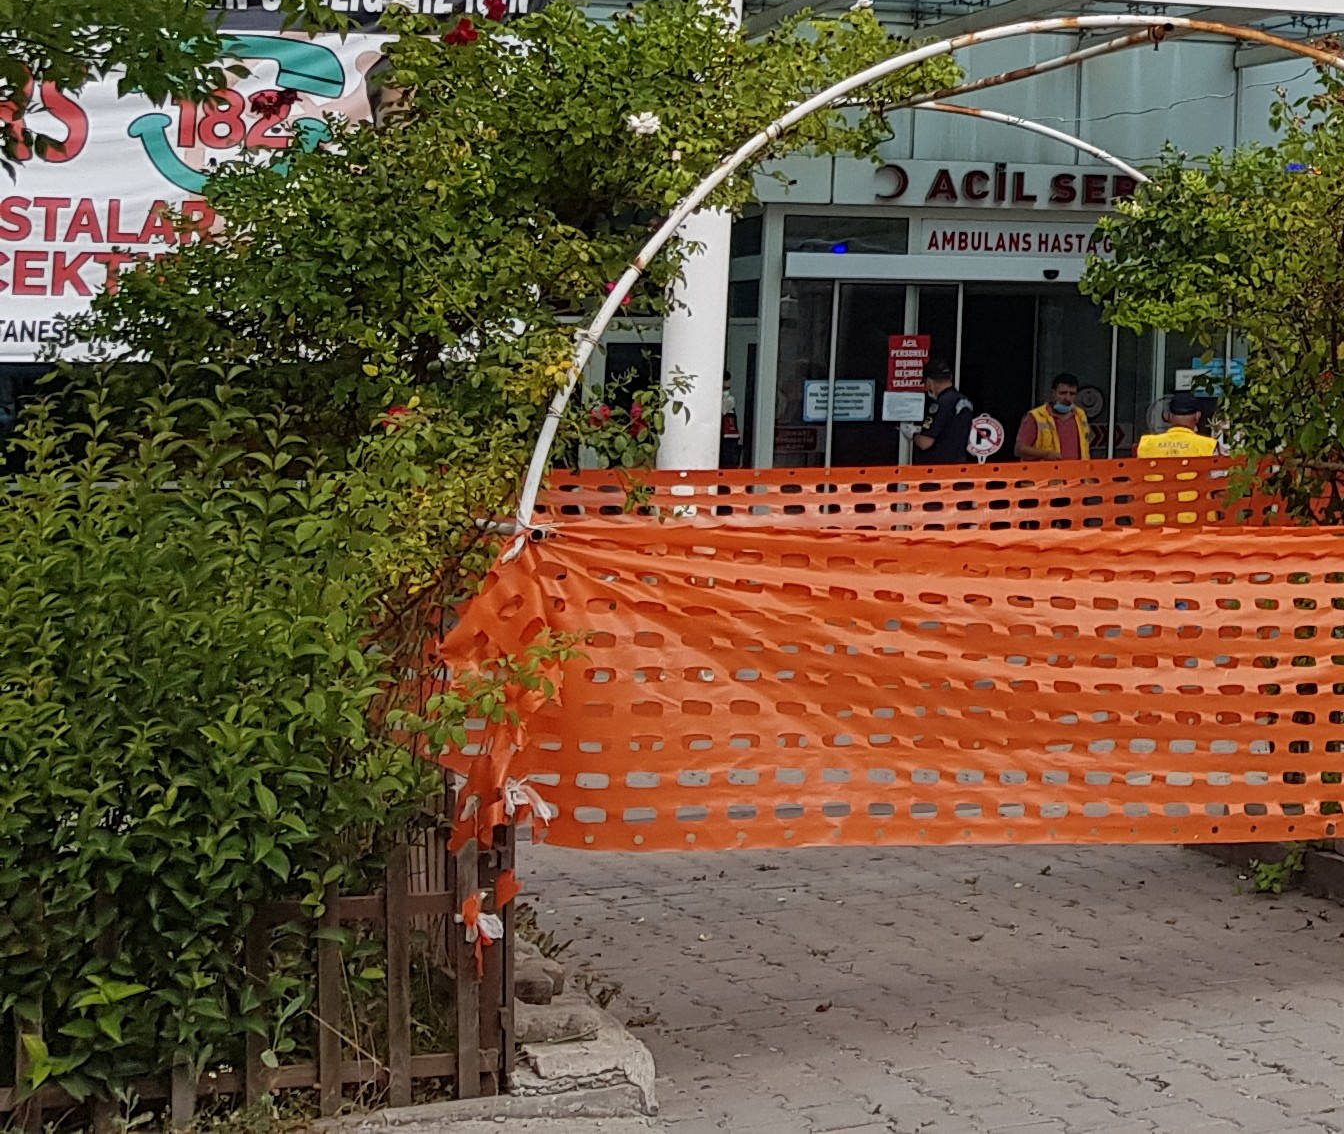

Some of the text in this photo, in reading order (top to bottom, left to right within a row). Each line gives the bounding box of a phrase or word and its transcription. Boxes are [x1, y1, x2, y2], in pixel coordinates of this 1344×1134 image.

[172, 88, 291, 149] 182
[925, 162, 1137, 204] ACİL SER
[927, 230, 1032, 252] AMBULANS
[1038, 233, 1097, 254] HASTA
